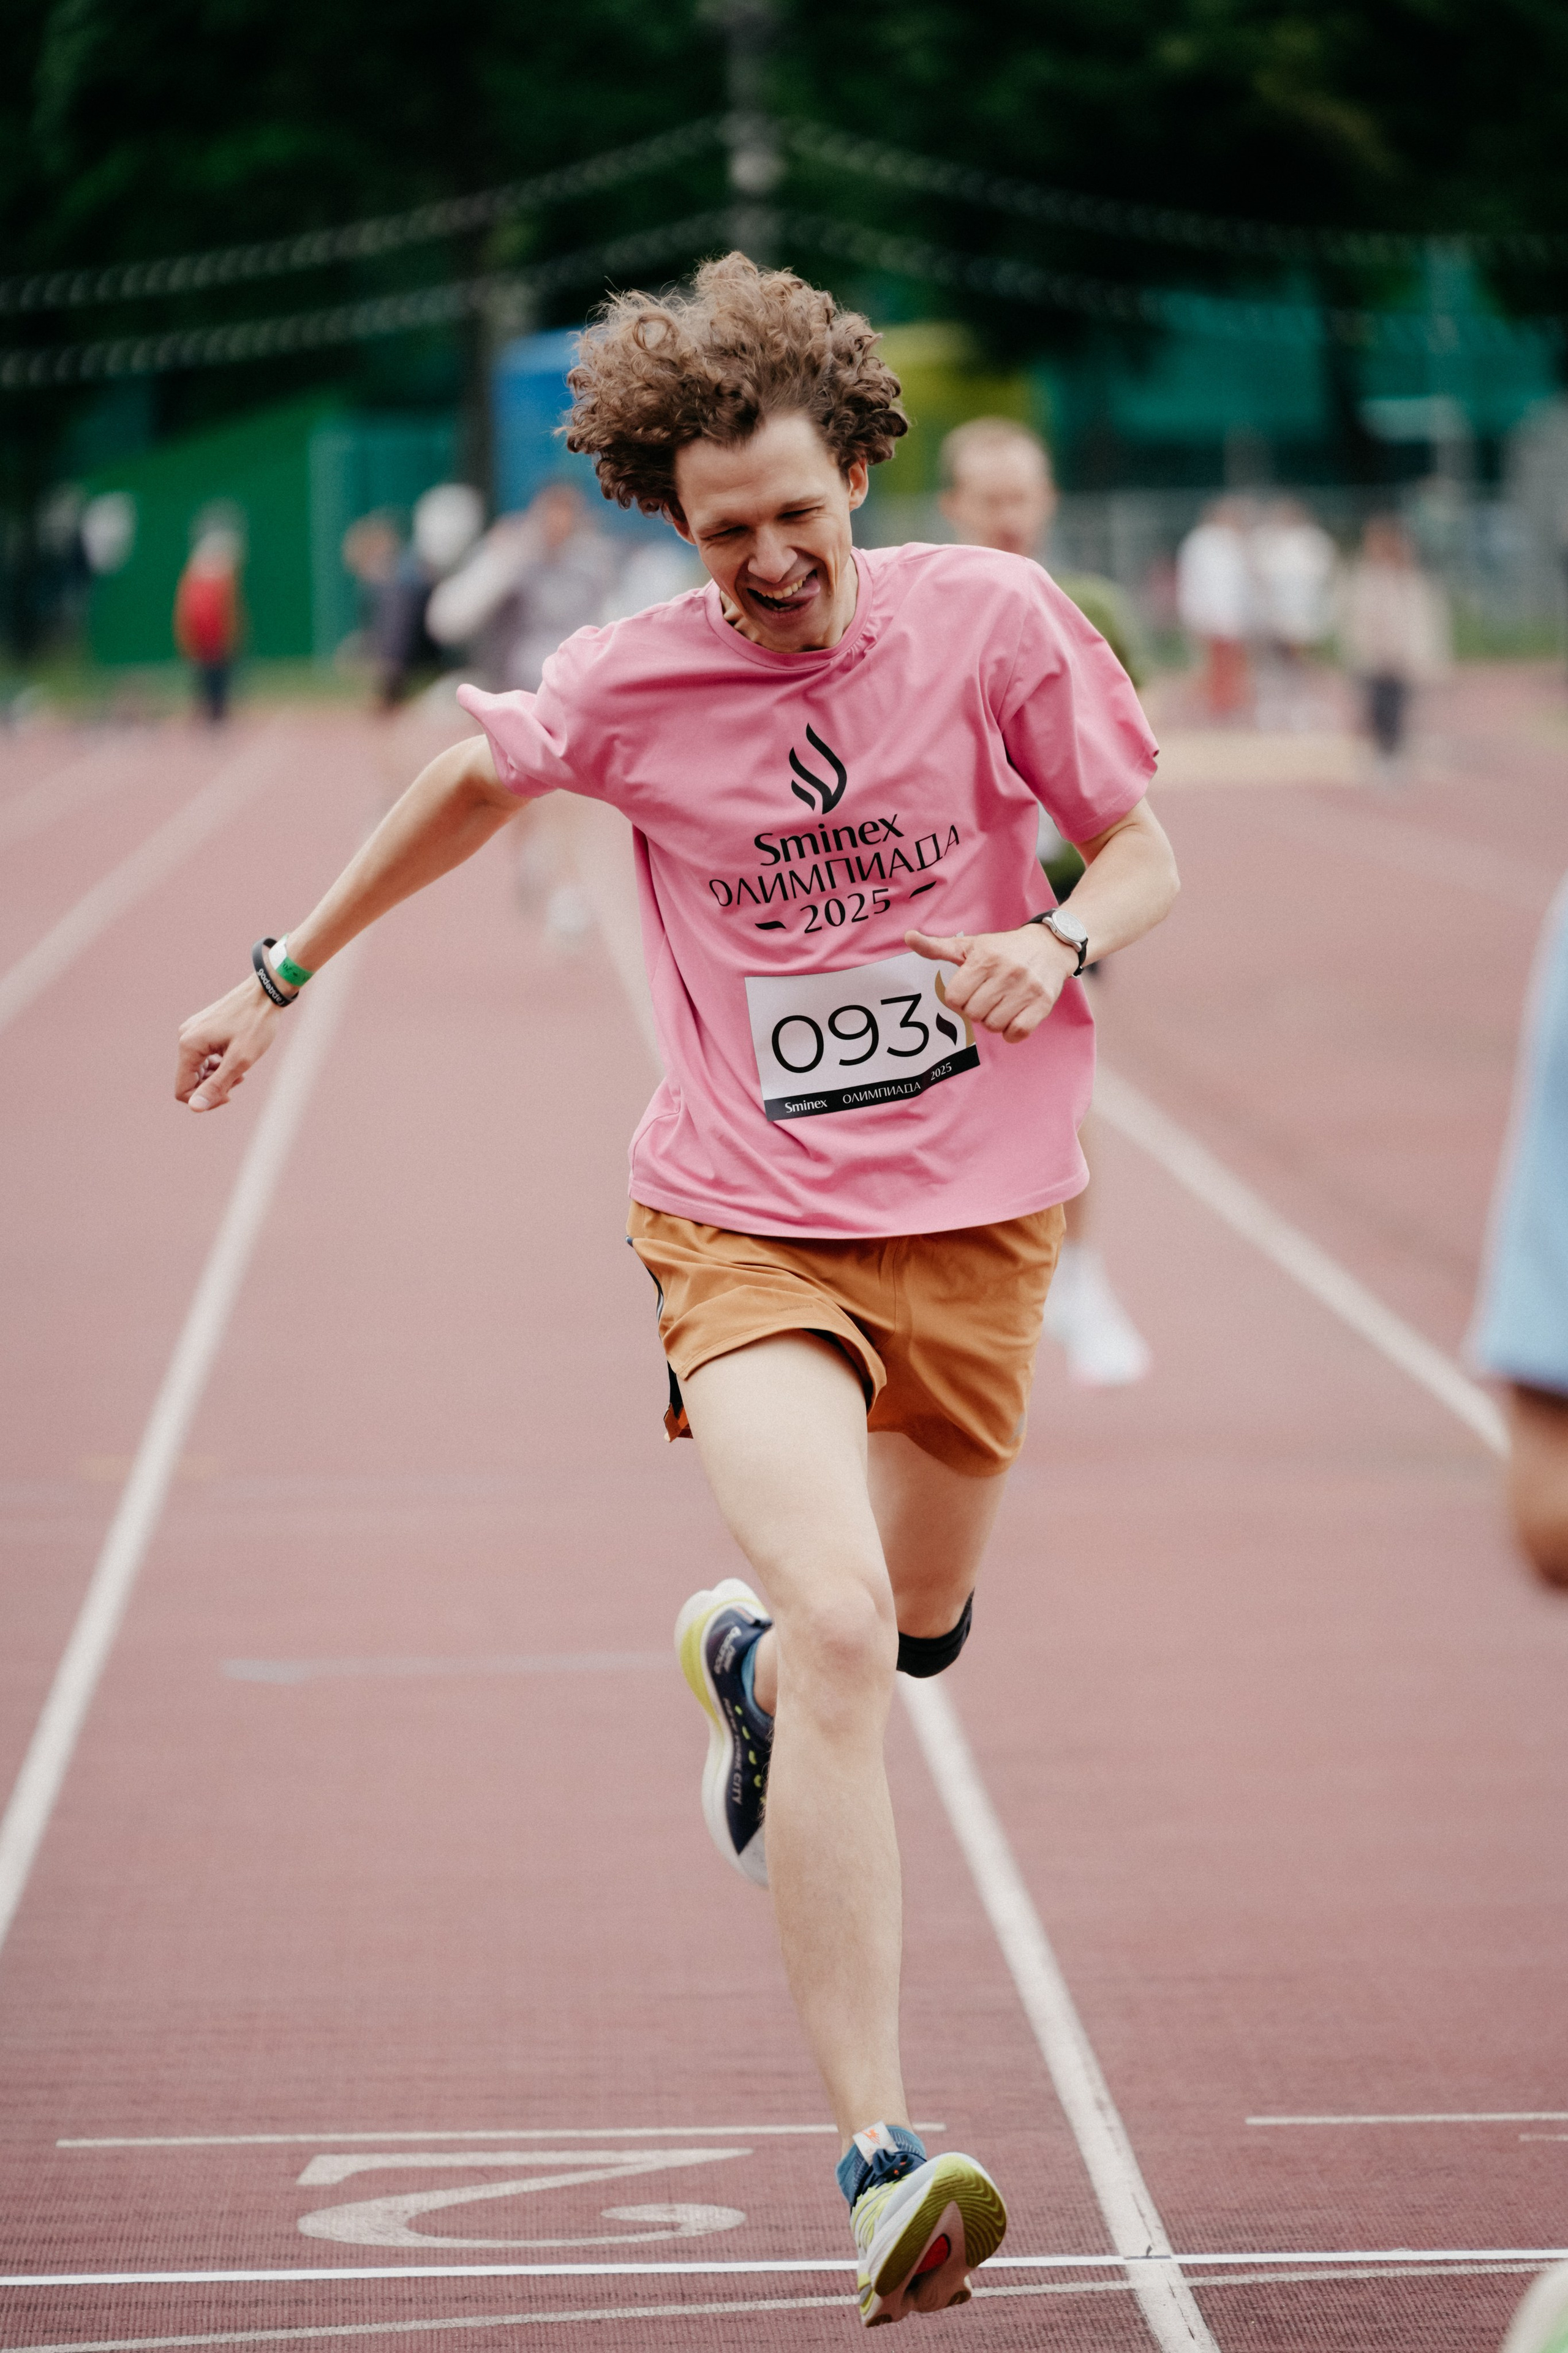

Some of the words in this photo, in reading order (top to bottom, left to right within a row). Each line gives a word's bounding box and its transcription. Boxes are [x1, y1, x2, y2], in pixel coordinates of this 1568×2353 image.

[755, 814, 905, 866] Sminex
[709, 825, 960, 907] ОЛИМПИАДА
[800, 888, 891, 934] 2025
[771, 992, 929, 1074] 093
[785, 1098, 828, 1113] Sminex
[842, 1082, 921, 1105] ОЛИМПИАДА
[930, 1062, 952, 1081] 2025
[732, 1772, 742, 1805] CITY
